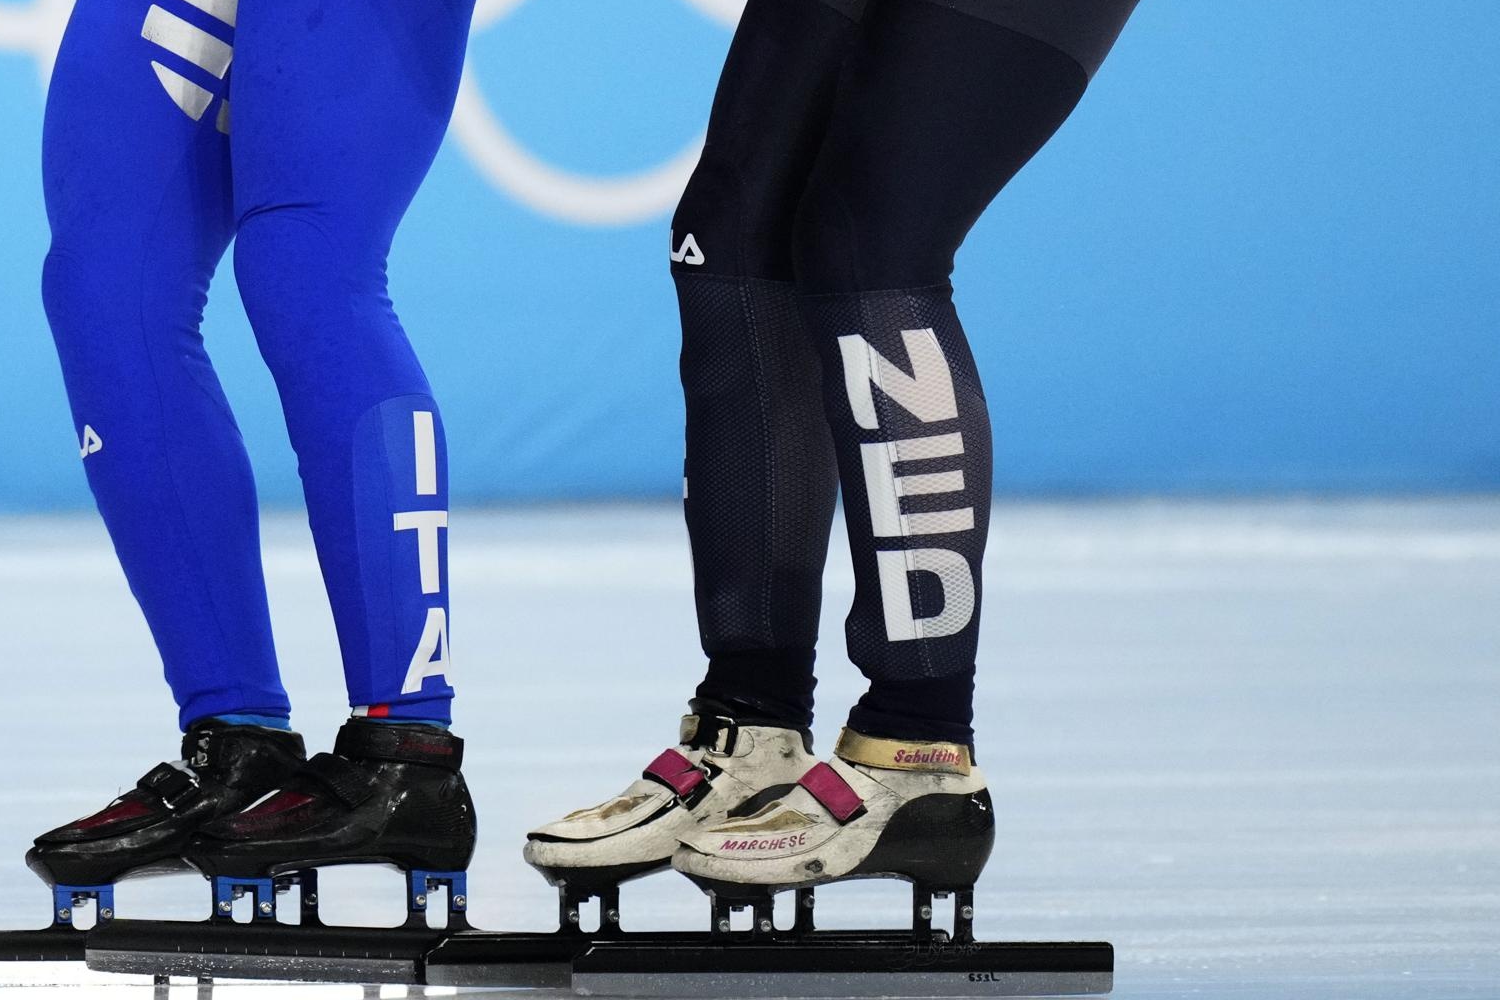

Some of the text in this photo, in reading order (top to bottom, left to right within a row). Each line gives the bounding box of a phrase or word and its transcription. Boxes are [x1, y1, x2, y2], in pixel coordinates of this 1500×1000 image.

[394, 411, 453, 695] ITA
[838, 328, 975, 641] NED
[720, 832, 806, 850] MARCHESE
